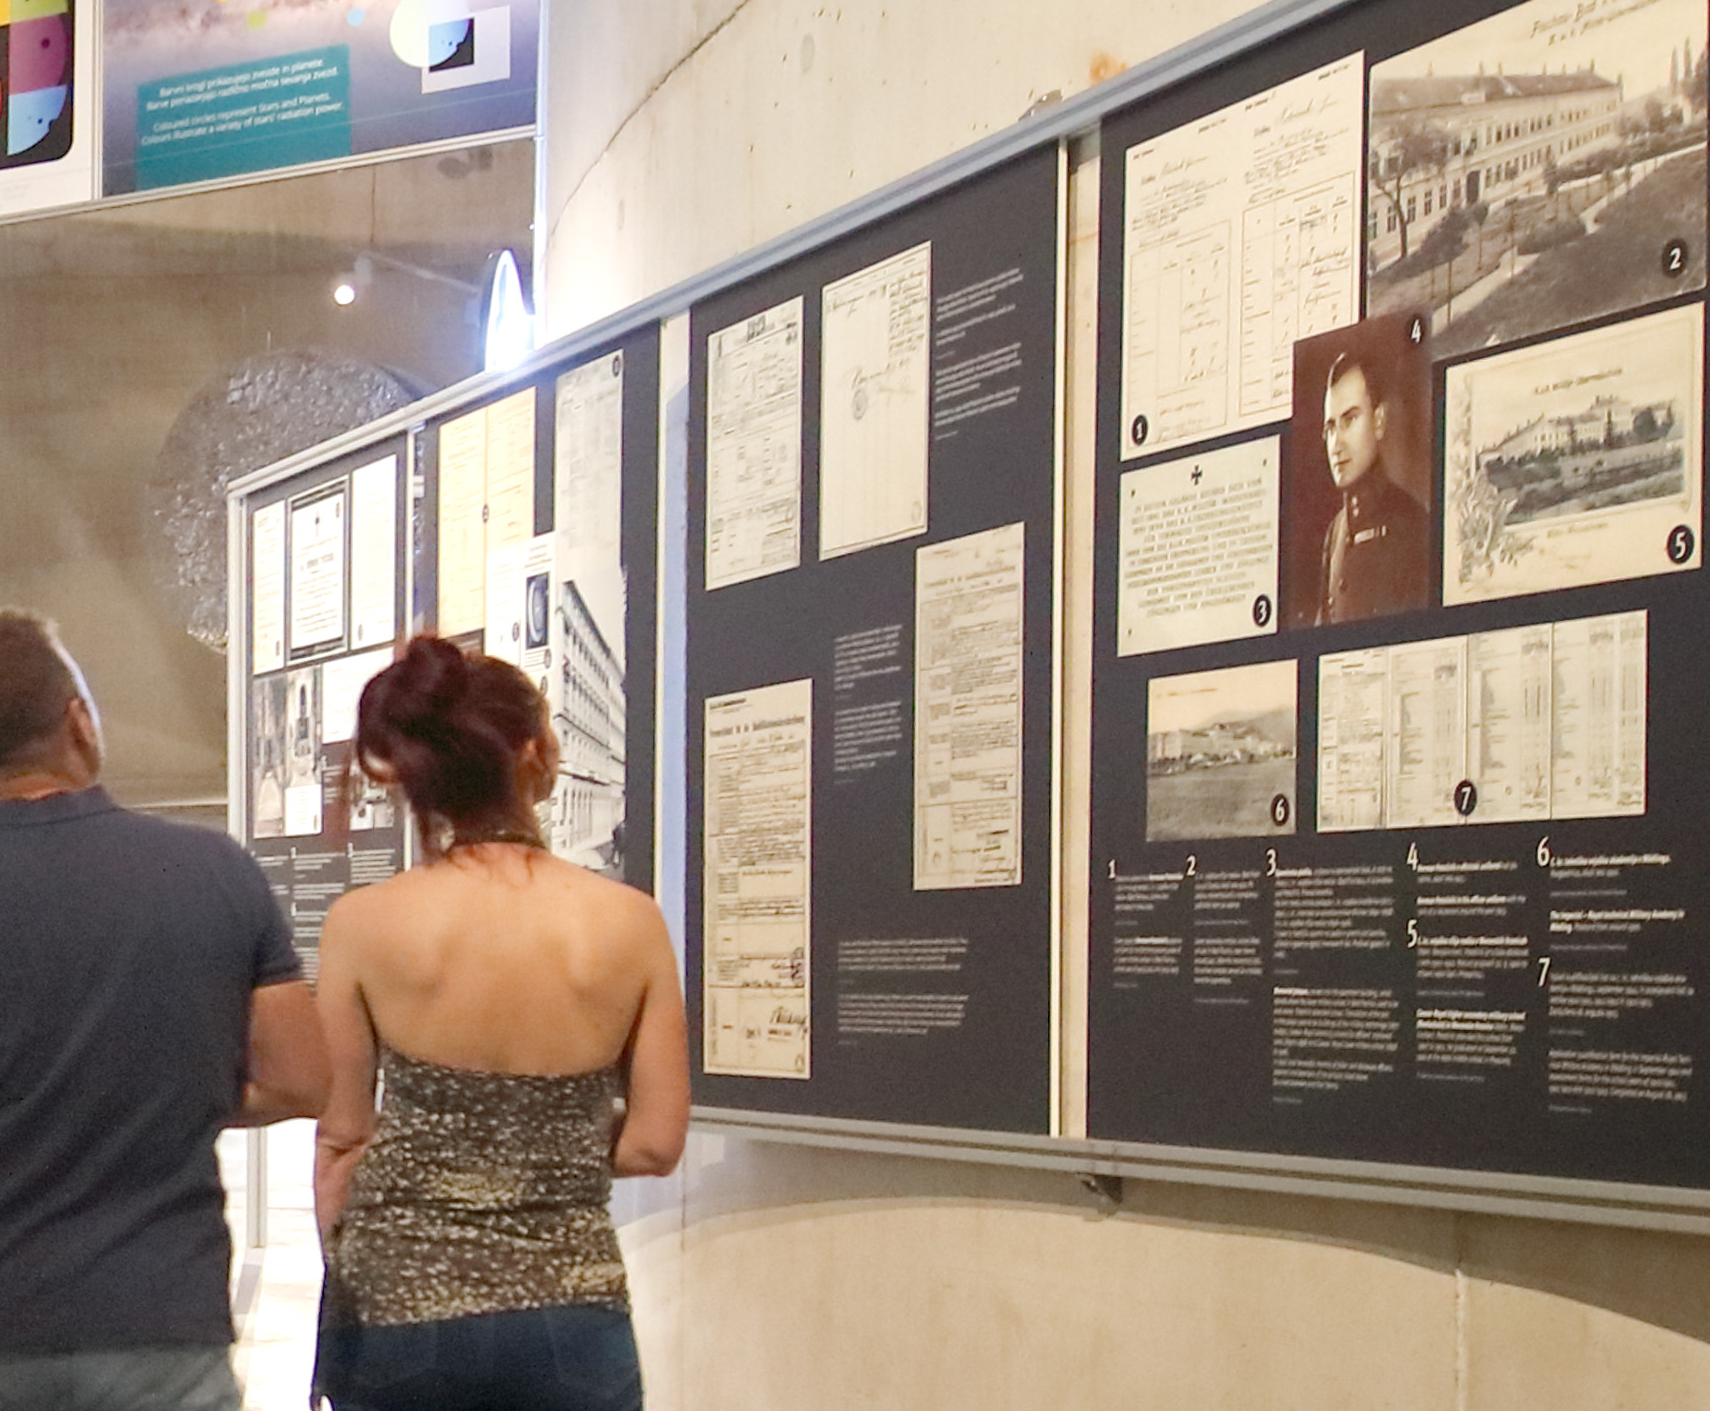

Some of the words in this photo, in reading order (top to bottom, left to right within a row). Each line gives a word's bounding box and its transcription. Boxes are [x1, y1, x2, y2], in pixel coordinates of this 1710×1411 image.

[1670, 248, 1681, 270] 2
[1411, 318, 1422, 343] 4
[1136, 423, 1143, 439] 1
[1675, 532, 1686, 558] 5
[1258, 601, 1267, 623] 3
[1275, 800, 1286, 822] 6
[1460, 786, 1471, 811] 7
[1267, 848, 1277, 876] 3
[1407, 842, 1418, 871] 4
[1537, 836, 1550, 867] 6
[1108, 859, 1116, 879] 1
[1187, 855, 1196, 876] 2
[1407, 920, 1417, 947] 5
[1538, 957, 1551, 987] 7
